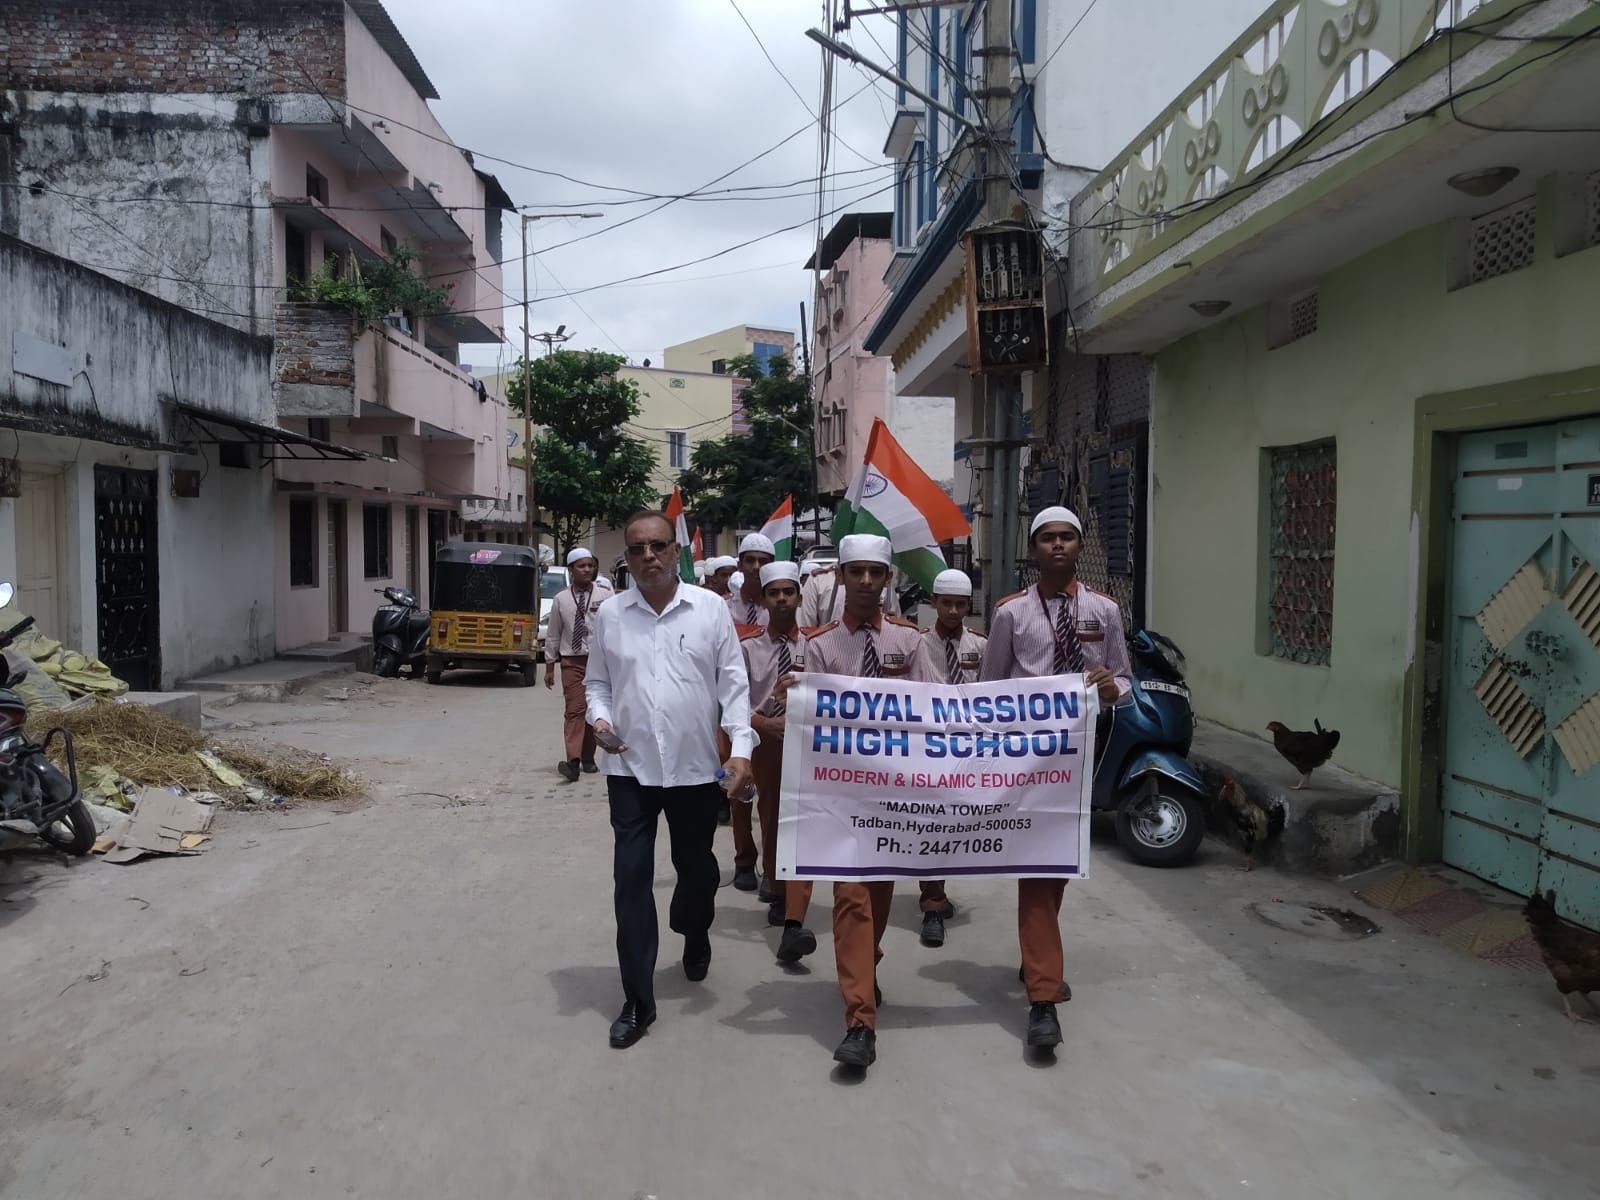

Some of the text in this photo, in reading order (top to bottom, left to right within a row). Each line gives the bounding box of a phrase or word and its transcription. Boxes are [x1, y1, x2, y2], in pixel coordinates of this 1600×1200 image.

[815, 689, 1080, 723] ROYAL MISSION
[812, 725, 1078, 758] HIGH SCHOOL
[813, 766, 1072, 789] MODERN & ISLAMIC EDUCATION
[850, 816, 1032, 834] Tadban,Hyderabad-500053
[876, 837, 1003, 856] Ph.: 24471086
